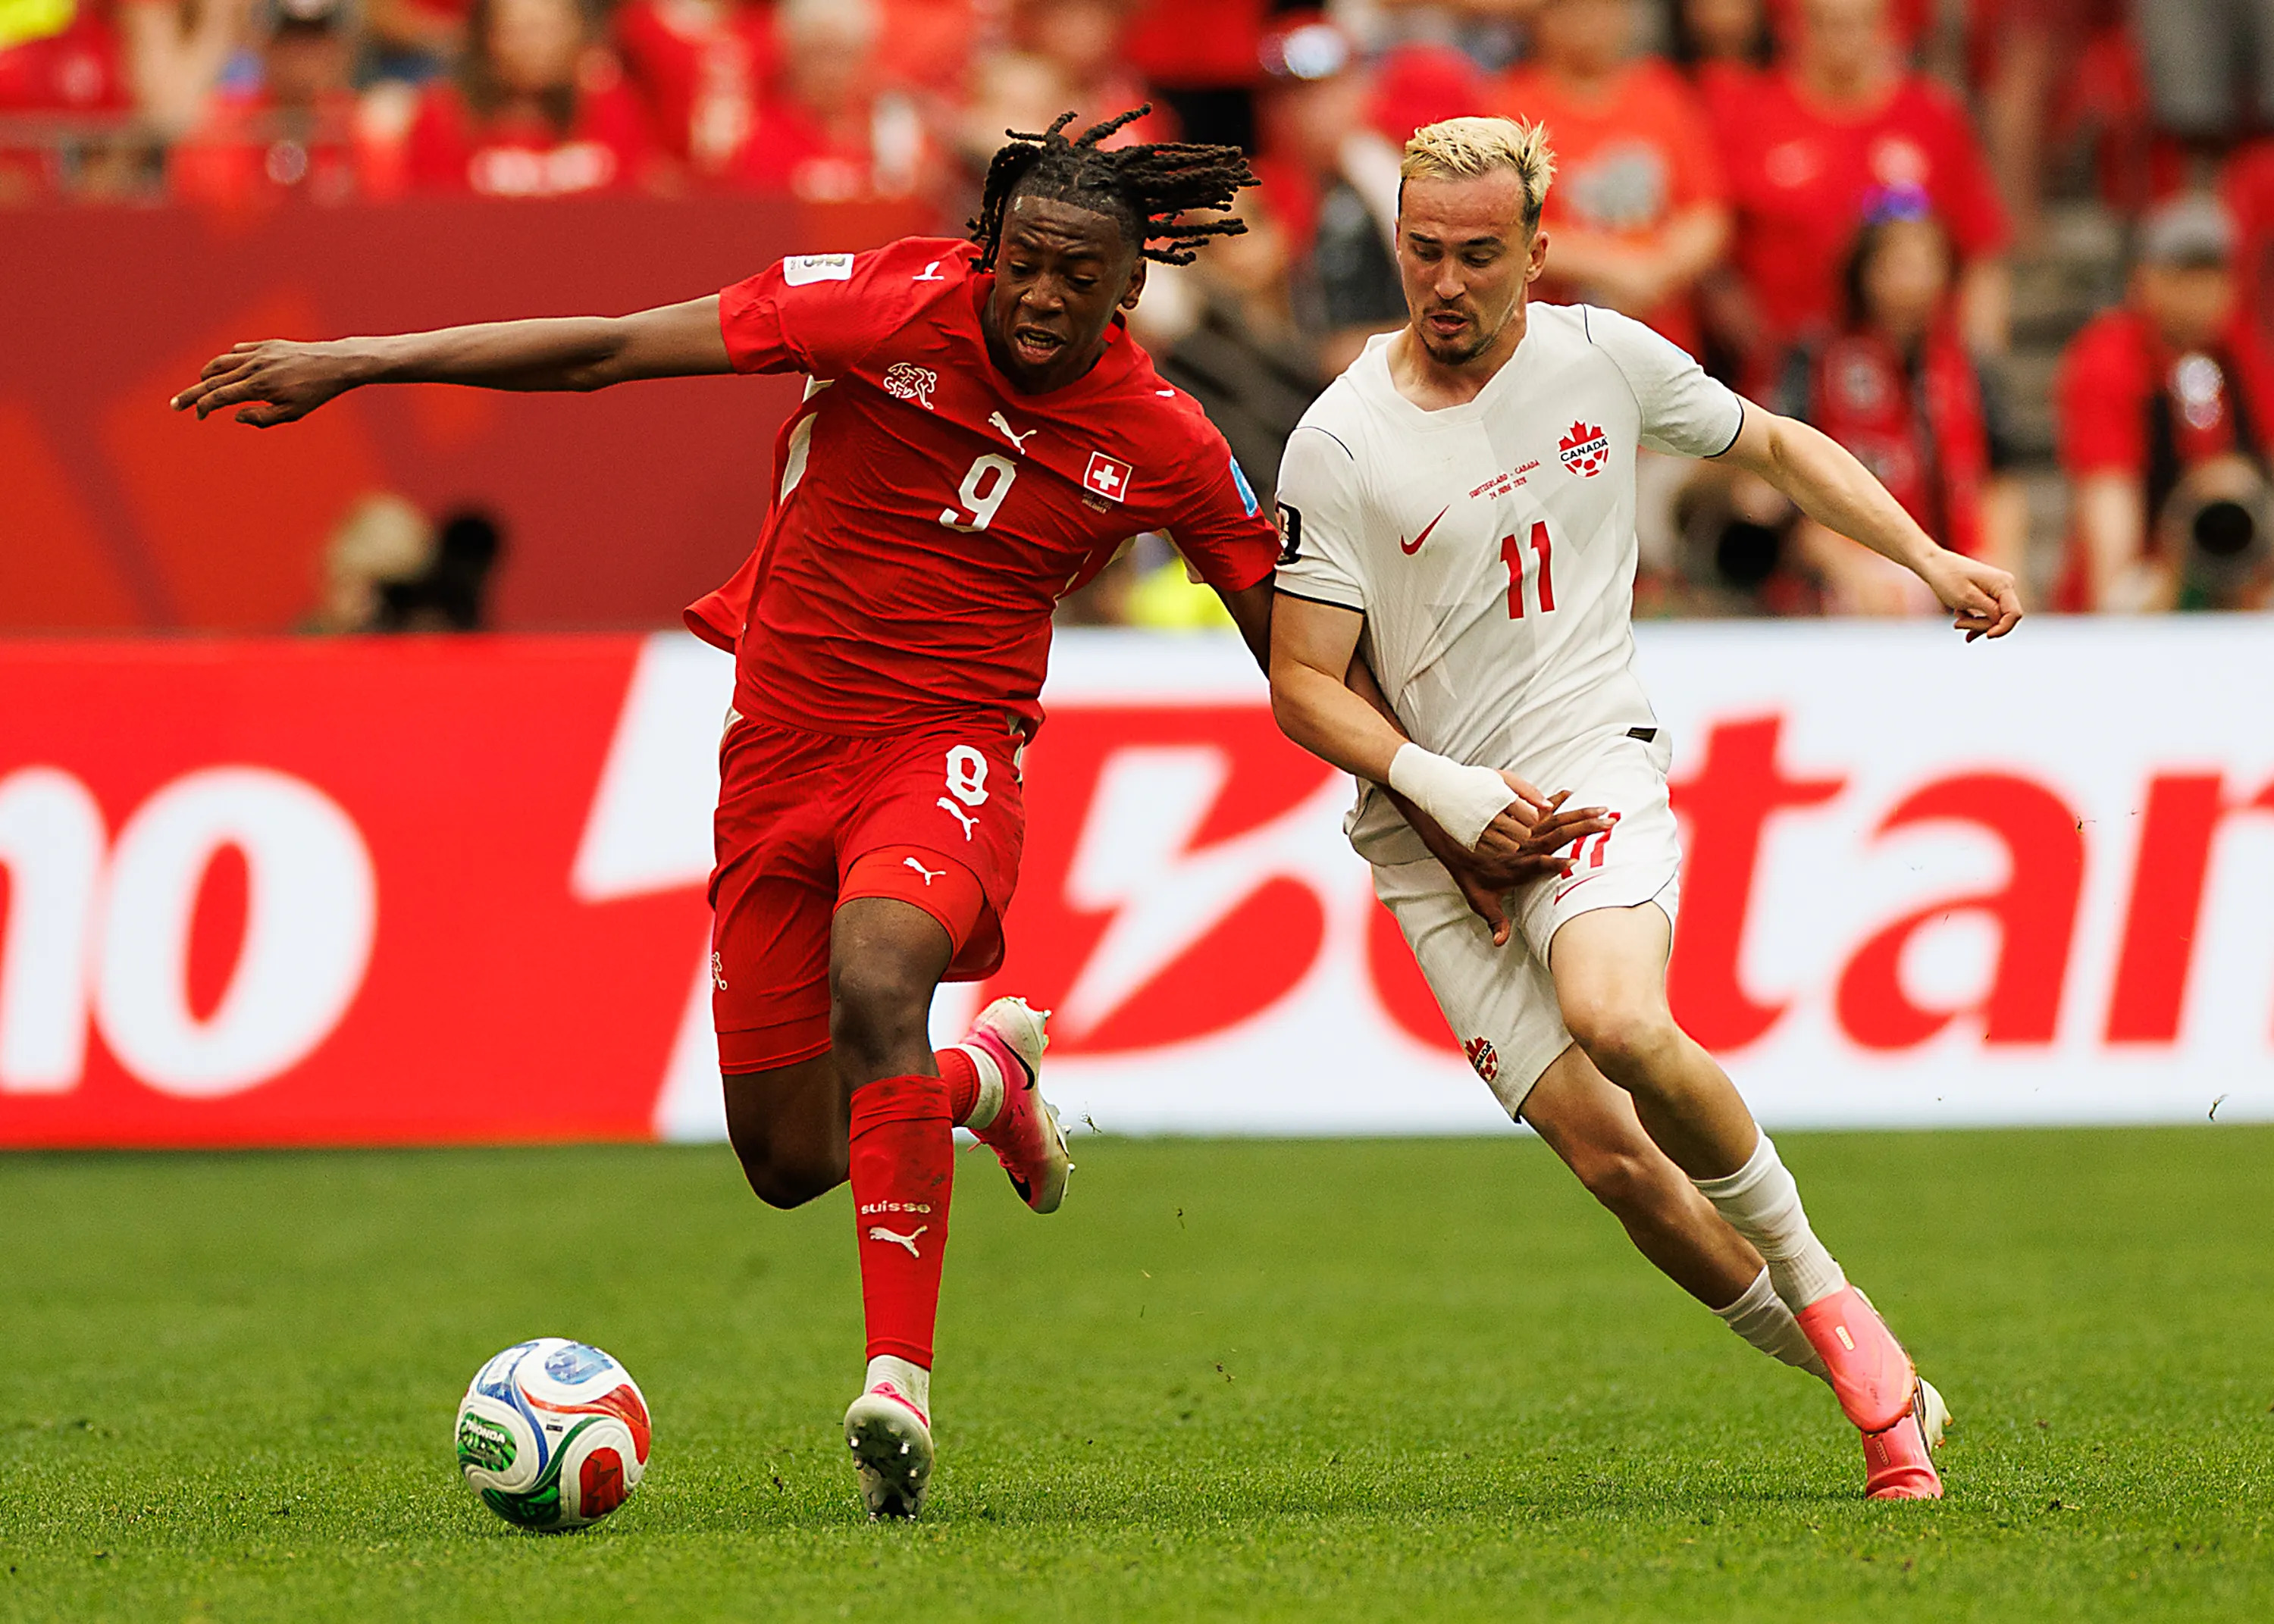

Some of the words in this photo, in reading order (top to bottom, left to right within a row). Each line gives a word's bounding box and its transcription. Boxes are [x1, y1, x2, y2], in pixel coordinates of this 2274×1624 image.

[1514, 459, 1540, 474] CANADA
[1560, 438, 1608, 461] CANADA
[939, 453, 1016, 532] 9
[1500, 520, 1555, 619] 11
[945, 745, 989, 806] 9
[861, 1200, 931, 1214] suisse
